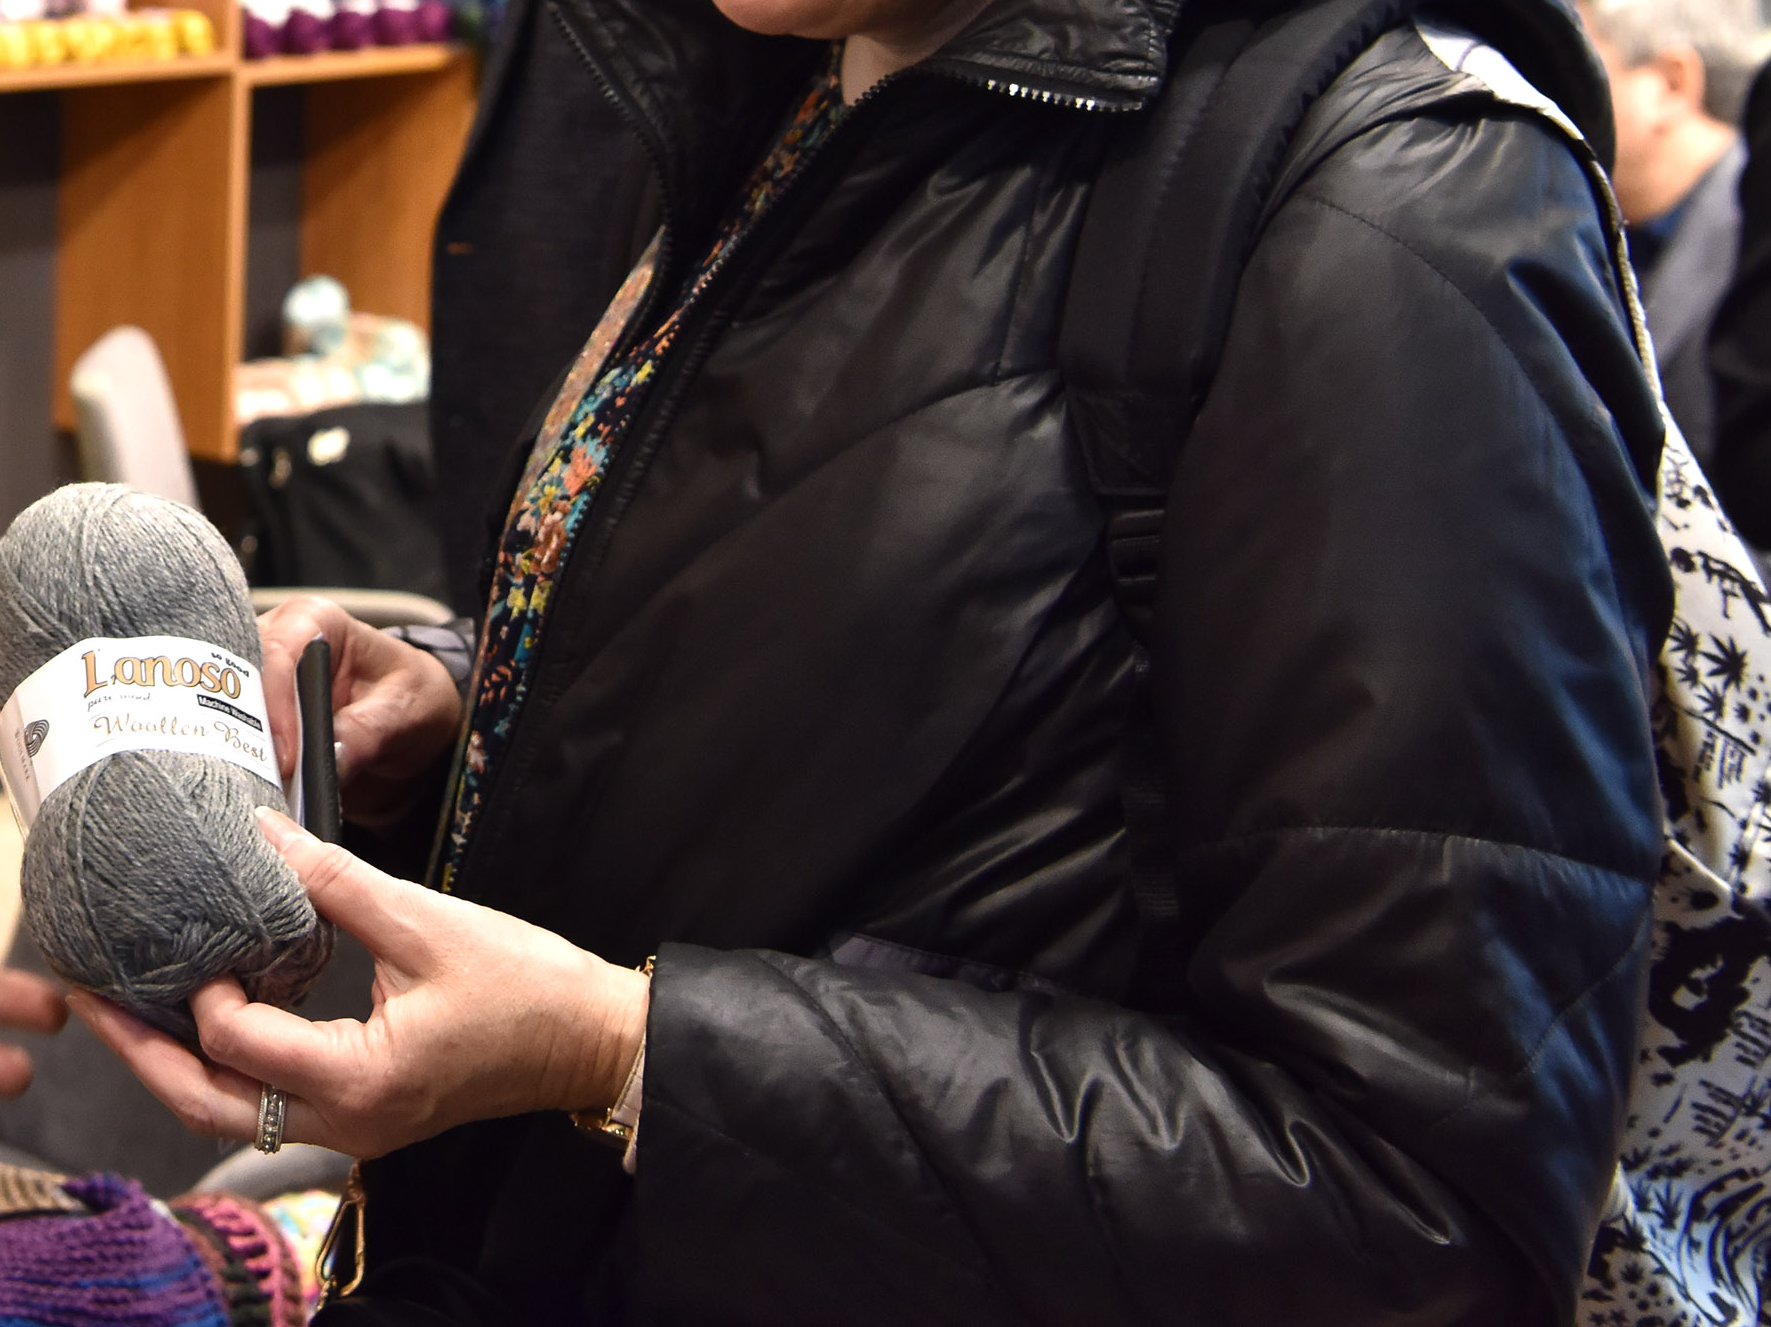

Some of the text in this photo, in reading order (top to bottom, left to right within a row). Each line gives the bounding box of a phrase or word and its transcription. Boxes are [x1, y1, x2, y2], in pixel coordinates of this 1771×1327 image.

[81, 649, 242, 699] Lanoso
[93, 712, 268, 762] Woollen Best
